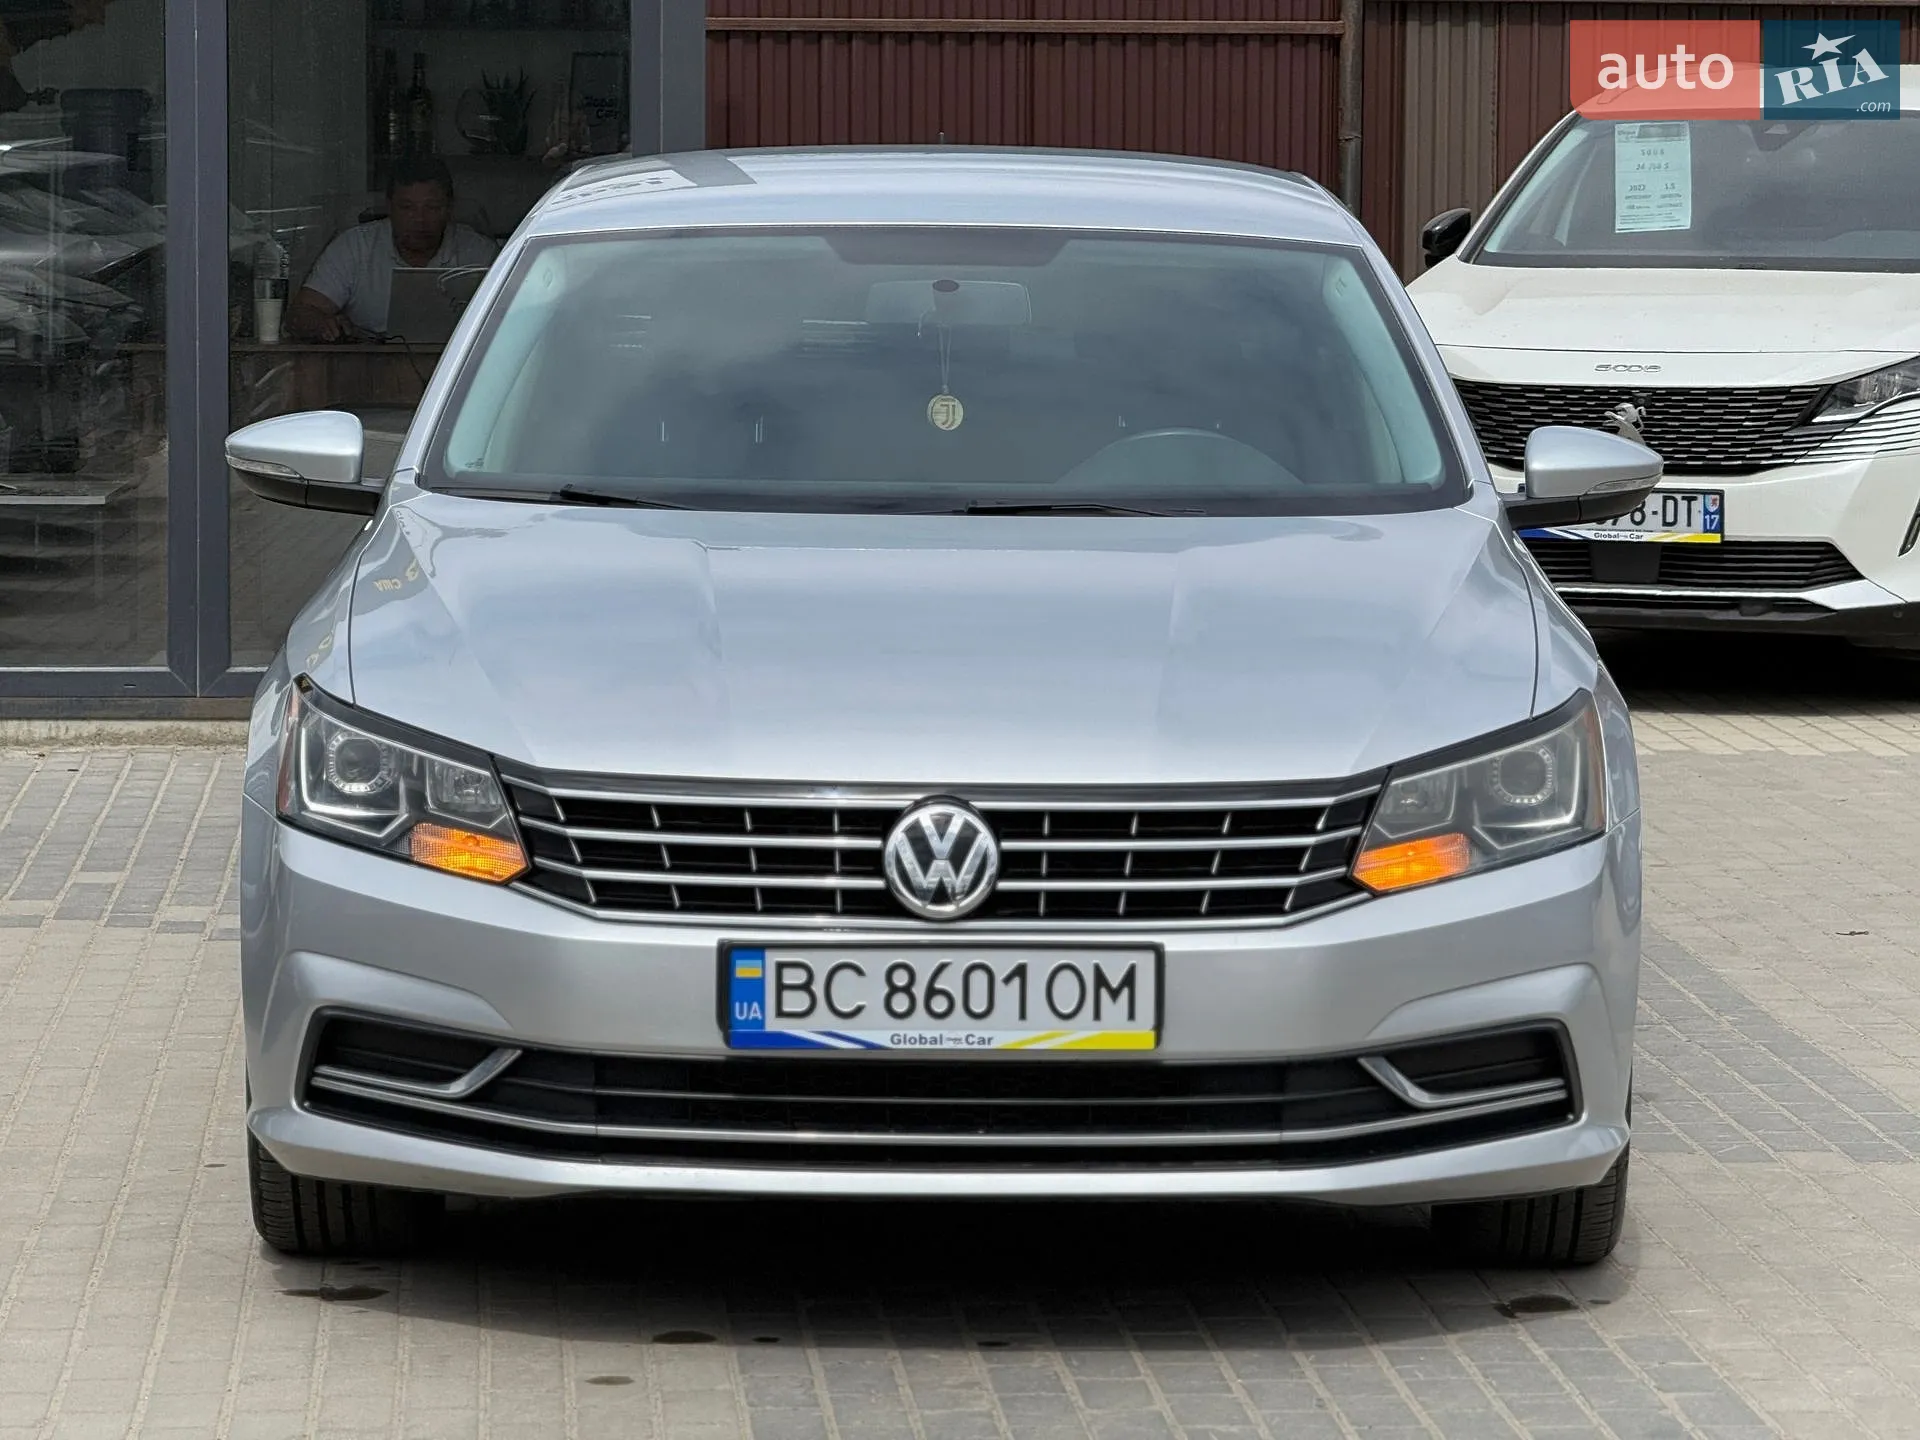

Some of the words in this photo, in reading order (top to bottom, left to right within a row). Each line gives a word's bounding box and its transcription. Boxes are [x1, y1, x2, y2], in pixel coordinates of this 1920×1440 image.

[1705, 514, 1719, 530] 17
[1594, 532, 1619, 540] Global
[734, 1001, 762, 1020] UA
[890, 1033, 943, 1046] Global
[965, 1034, 994, 1046] Car
